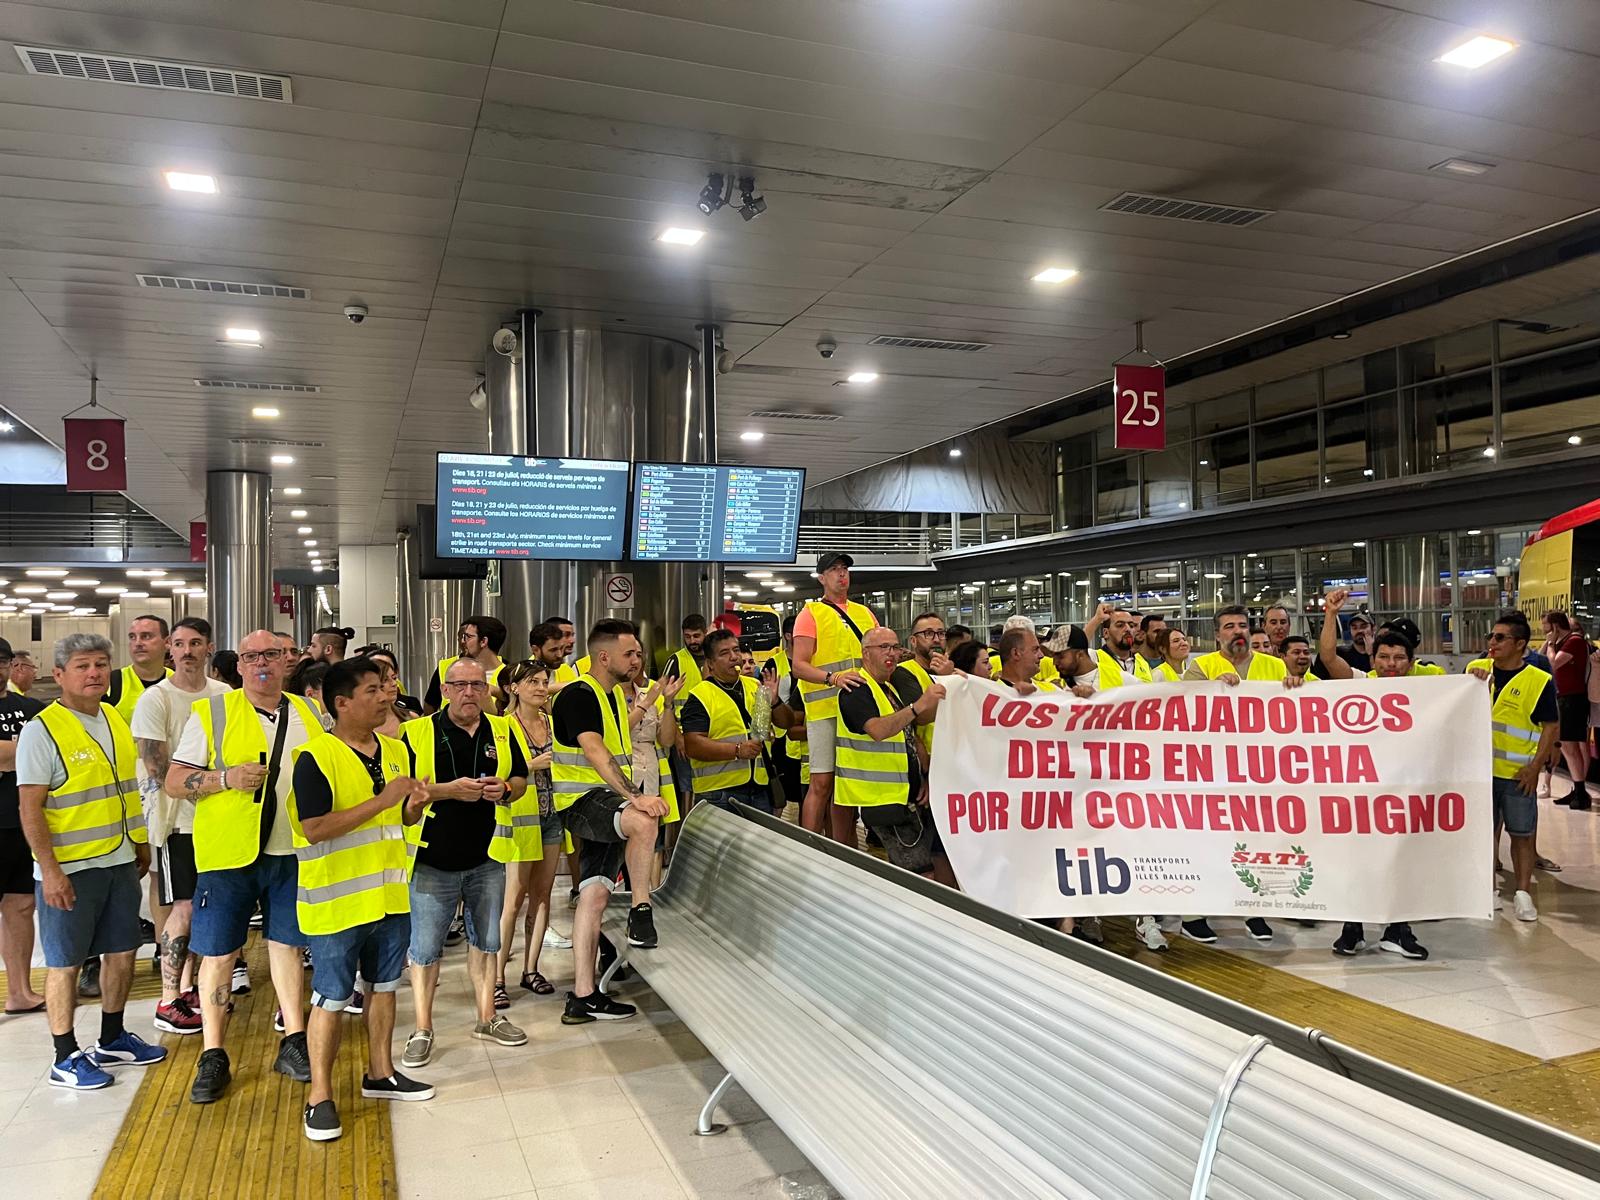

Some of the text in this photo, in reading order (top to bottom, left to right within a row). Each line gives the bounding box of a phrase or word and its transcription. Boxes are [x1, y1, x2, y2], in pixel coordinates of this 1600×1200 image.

[1122, 389, 1160, 427] 25
[86, 439, 109, 471] 8
[283, 600, 290, 609] 4
[1552, 593, 1569, 613] IKEA
[981, 693, 1413, 734] LOS TRABAJADOR@S
[1007, 739, 1379, 784] DEL TIB EN LUCHA
[948, 790, 1465, 835] POR UN CONVENIO DIGNO
[1055, 847, 1132, 897] tib
[1231, 851, 1309, 868] SATI
